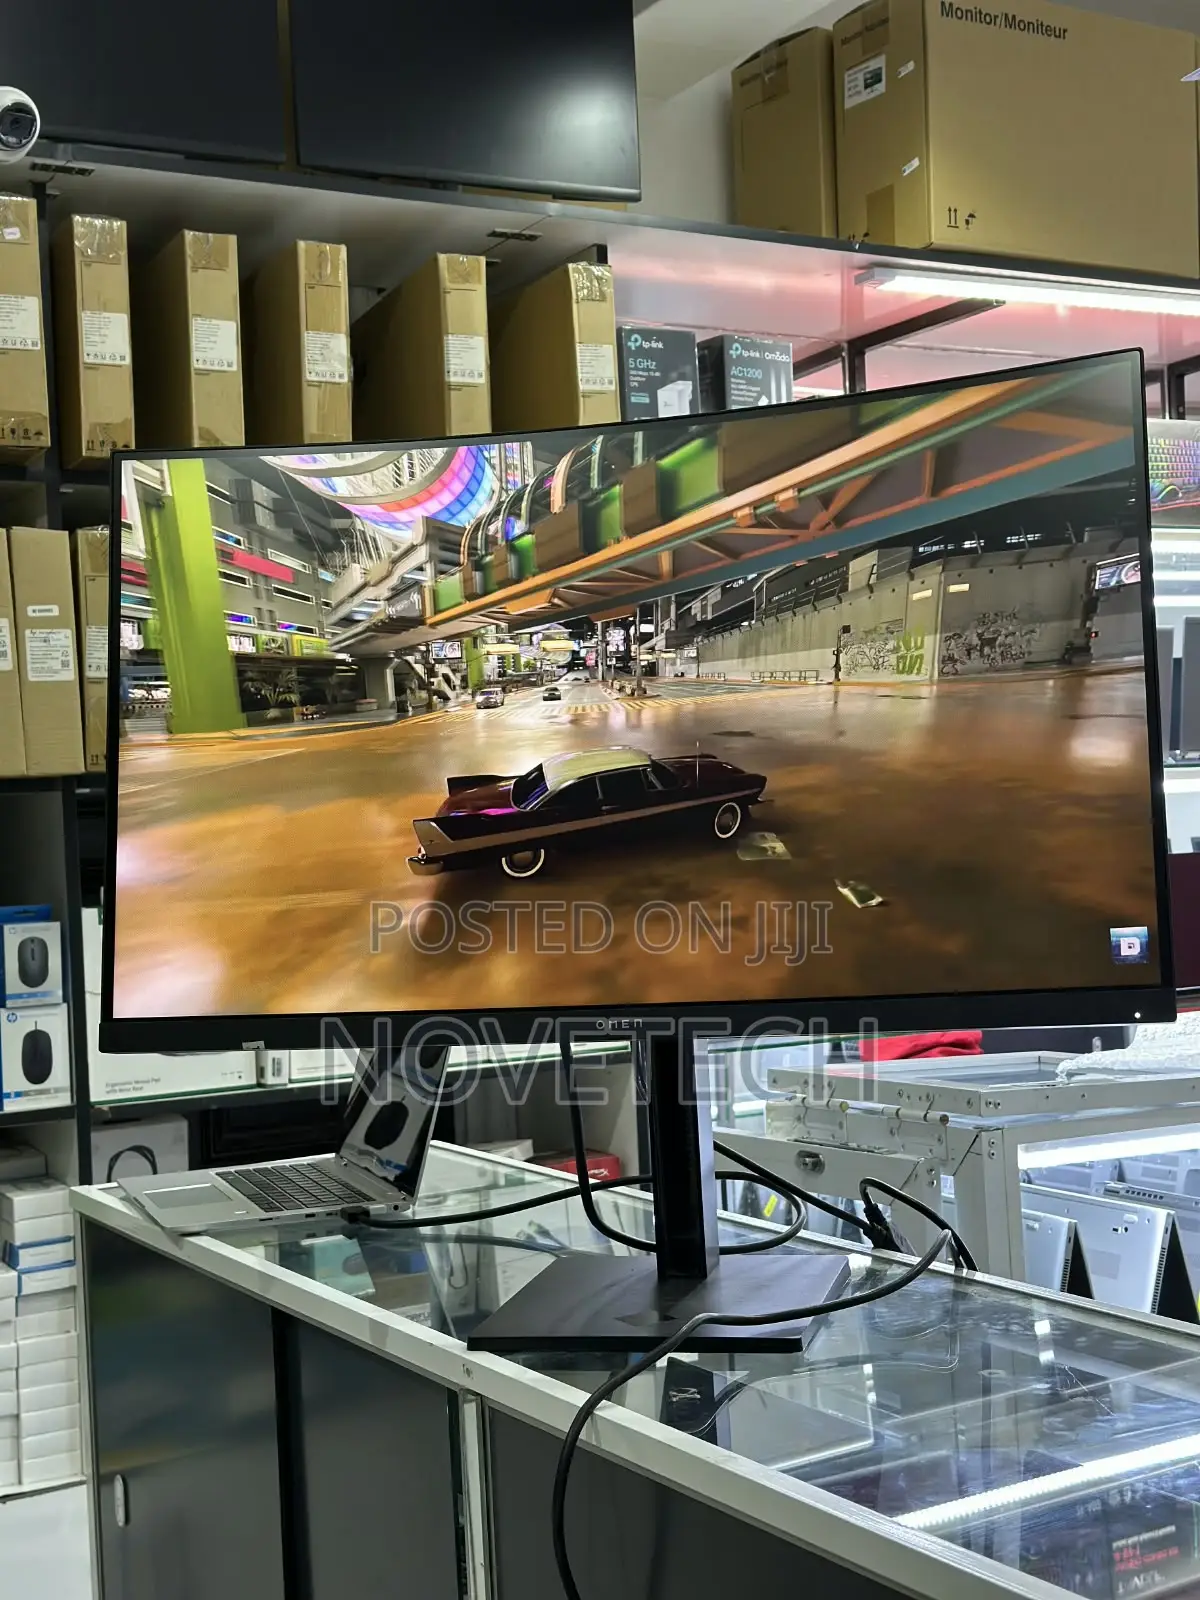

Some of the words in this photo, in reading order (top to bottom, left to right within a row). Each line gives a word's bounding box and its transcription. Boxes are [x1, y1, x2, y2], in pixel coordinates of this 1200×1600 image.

[940, 1, 1067, 40] Monitor/Moniteur
[642, 336, 664, 349] tp-link
[628, 357, 635, 368] 5
[636, 358, 656, 370] GHz
[730, 366, 763, 379] AC1200
